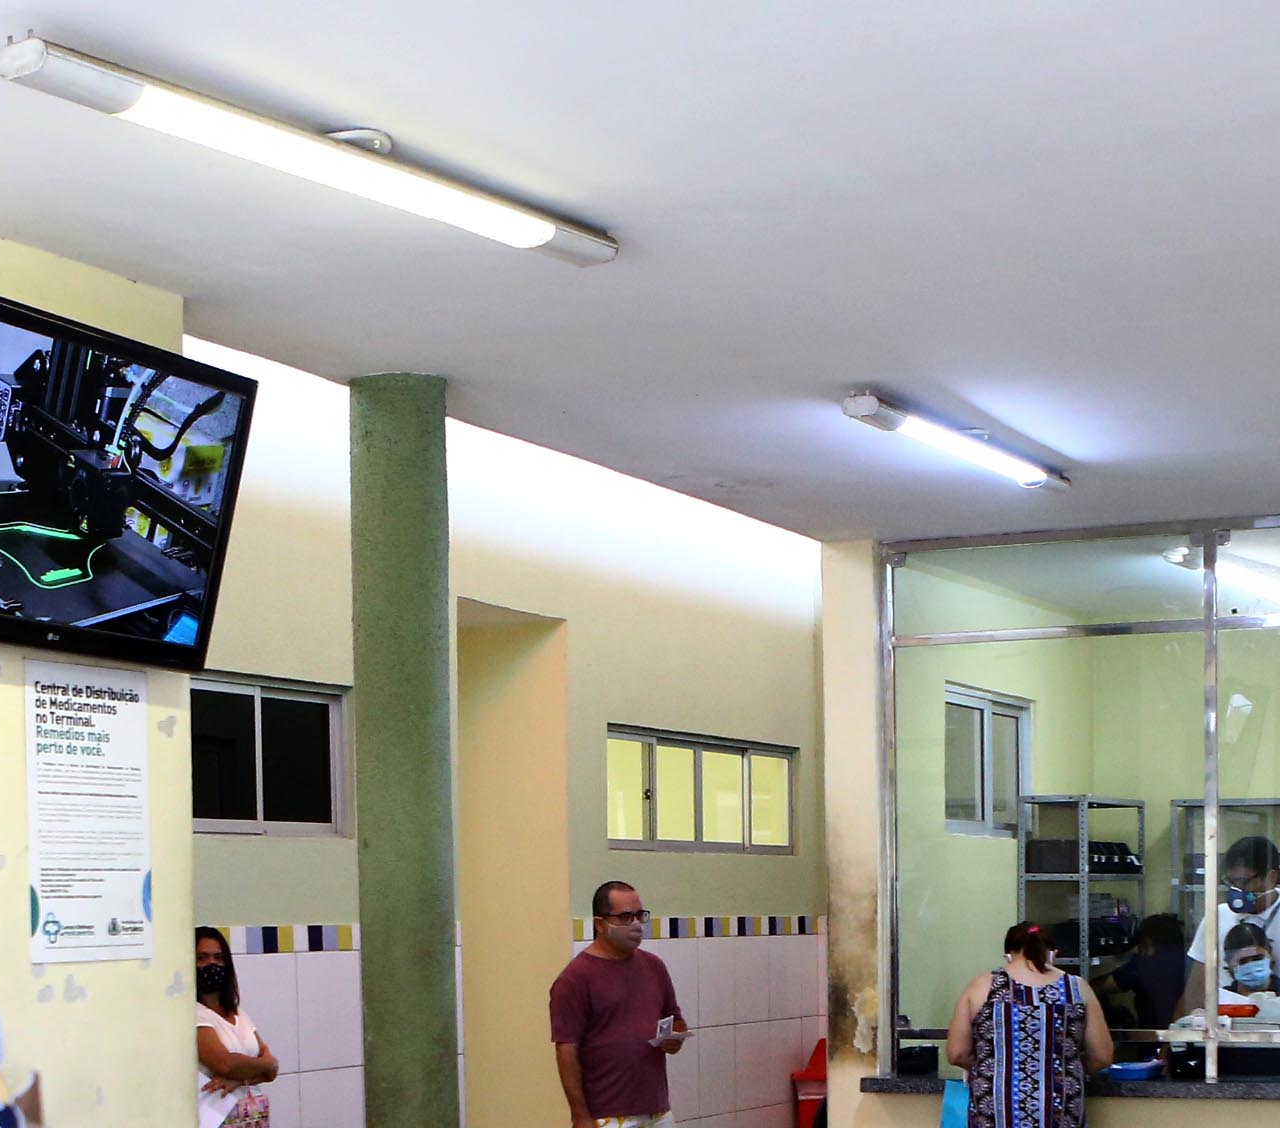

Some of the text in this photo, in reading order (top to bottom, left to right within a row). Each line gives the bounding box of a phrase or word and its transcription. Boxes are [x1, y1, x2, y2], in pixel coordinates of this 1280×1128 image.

[34, 681, 140, 705] Central de Distribuição
[35, 697, 117, 715] de Medicamentos
[36, 713, 48, 724] no
[87, 729, 111, 743] mais
[36, 742, 64, 756] perto
[66, 742, 78, 755] de
